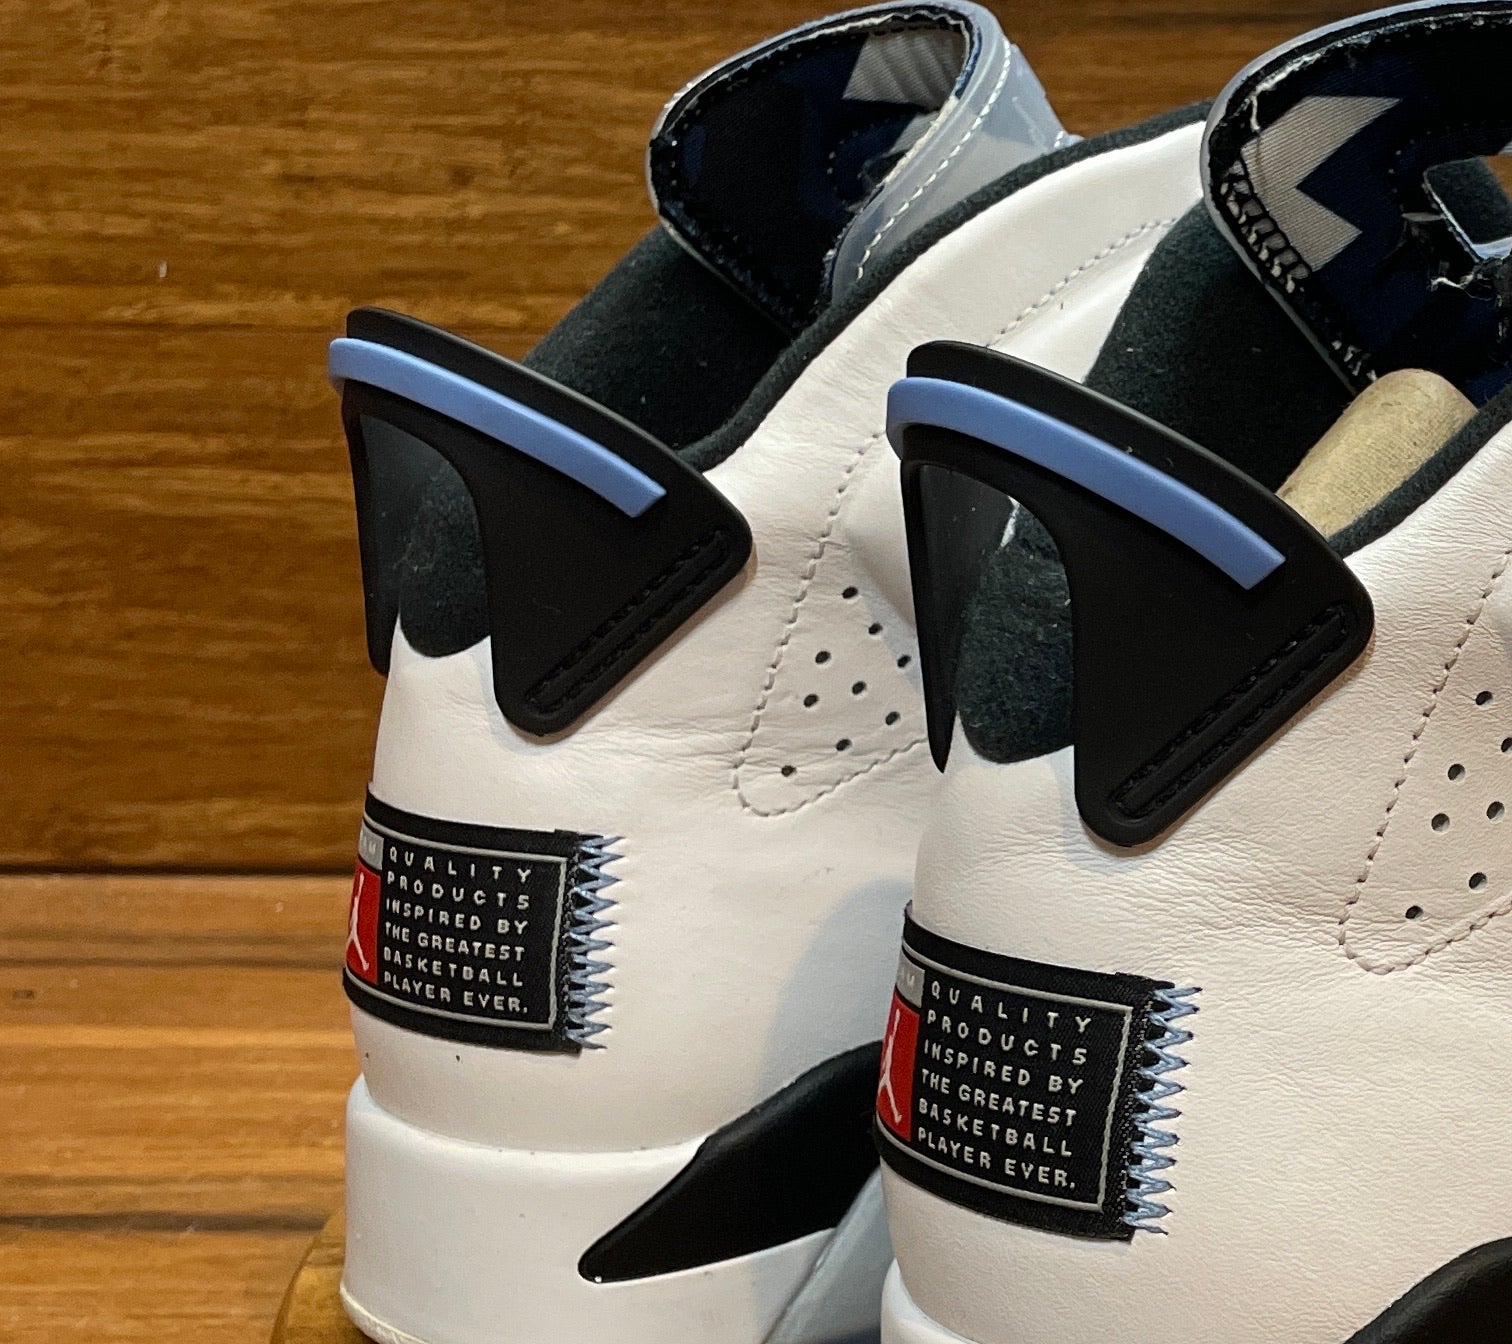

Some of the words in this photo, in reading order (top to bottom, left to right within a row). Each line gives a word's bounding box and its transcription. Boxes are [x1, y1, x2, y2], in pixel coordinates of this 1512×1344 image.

[389, 845, 531, 883] QUALITY
[387, 870, 529, 910] PRODUCTS
[385, 897, 481, 931] INSPIRED
[497, 919, 528, 934] BY
[384, 921, 410, 943] THE
[417, 932, 525, 962] GREATEST
[383, 946, 523, 987] BASKETBALL
[383, 970, 451, 1002] PLAYER
[463, 990, 528, 1014] EVER.
[931, 980, 1092, 1033] QUALITY
[927, 1009, 1087, 1066] PRODUCTS
[924, 1039, 1031, 1086] INSPIRED
[1048, 1075, 1084, 1095] BY
[921, 1068, 950, 1094] THE
[958, 1084, 1076, 1127] GREATEST
[918, 1098, 1072, 1156] BASKETBALL
[918, 1126, 991, 1170] PLAYER
[1004, 1158, 1076, 1189] EVER.
